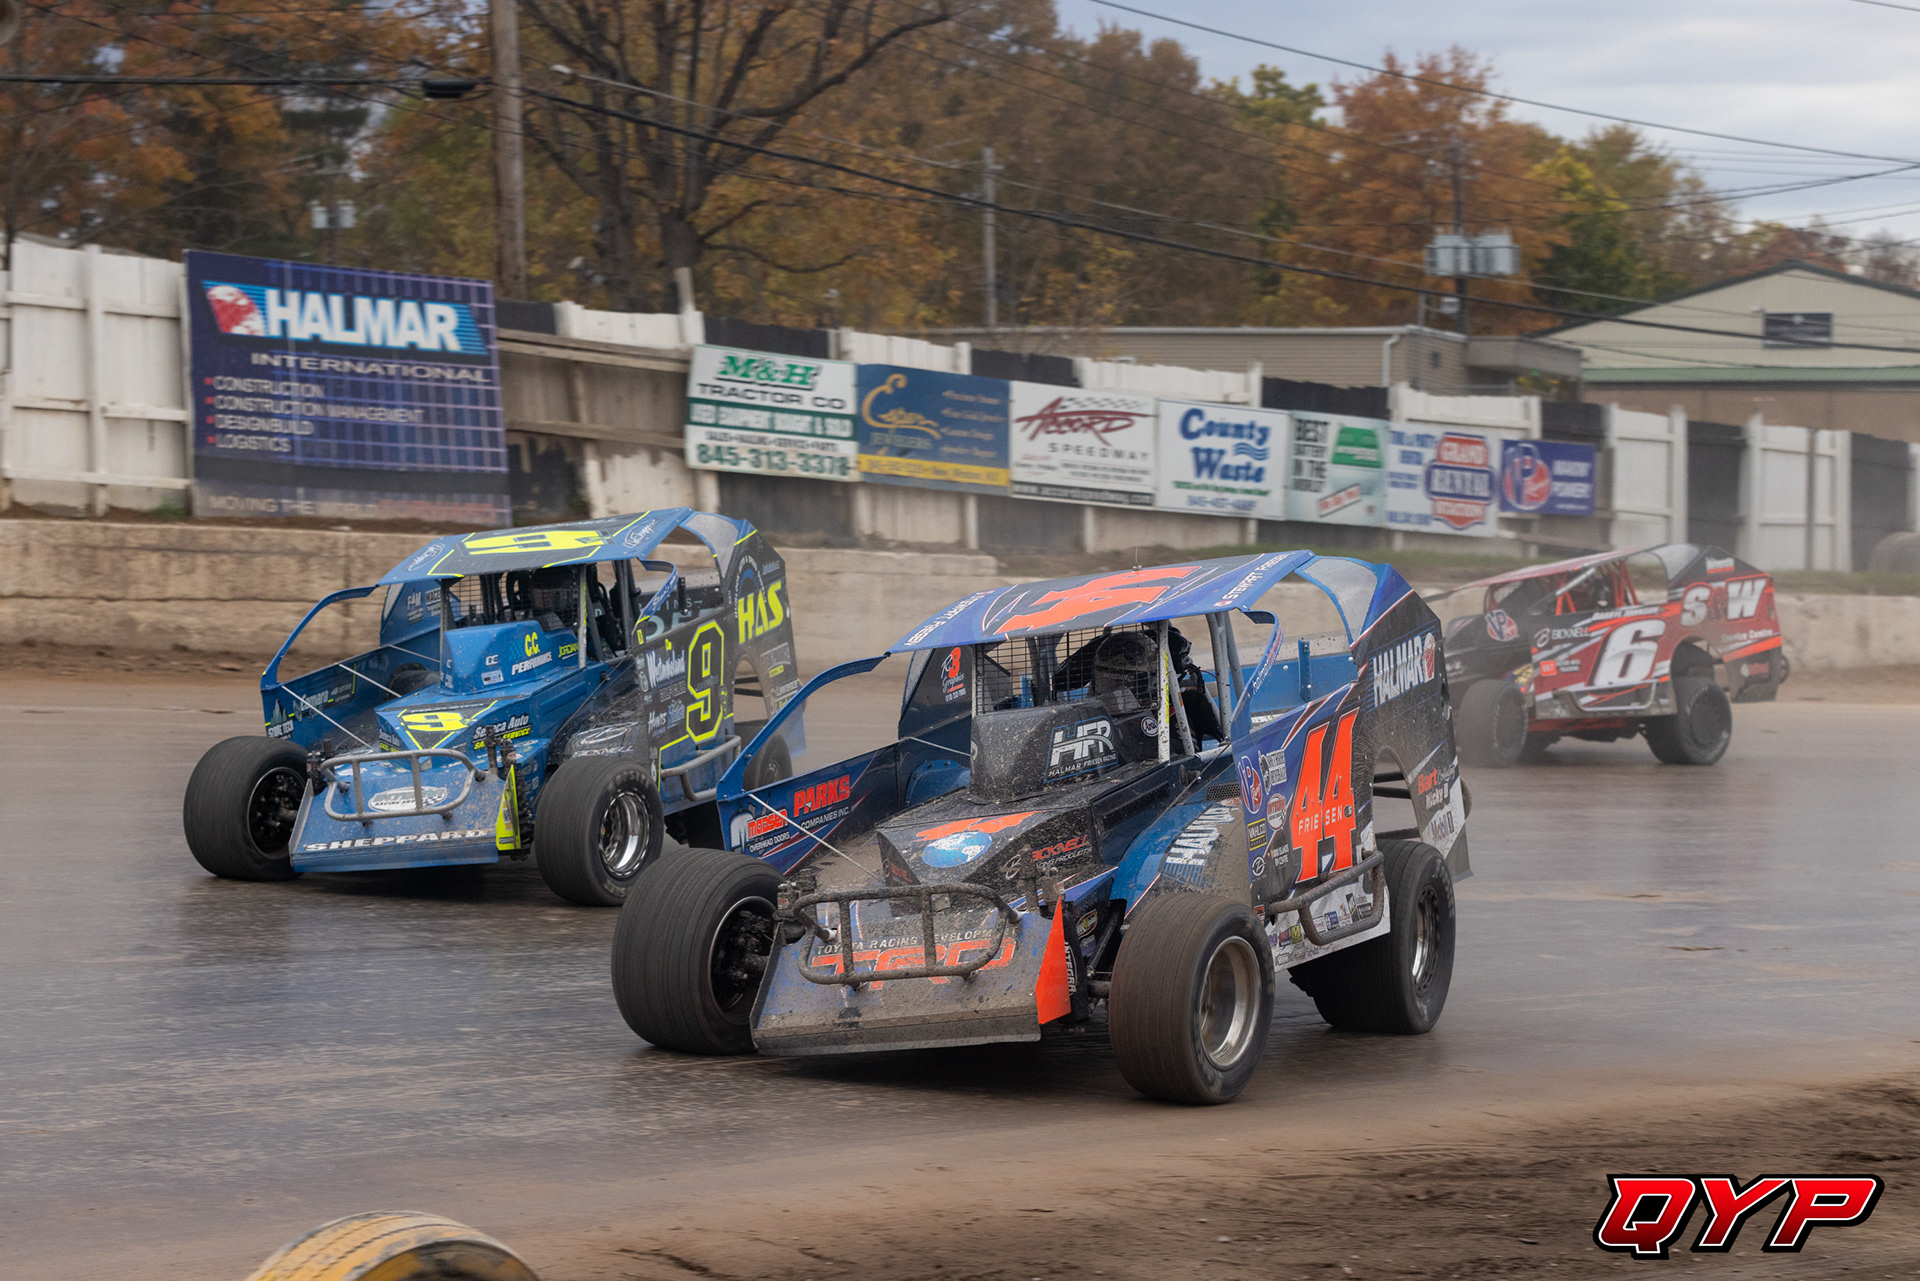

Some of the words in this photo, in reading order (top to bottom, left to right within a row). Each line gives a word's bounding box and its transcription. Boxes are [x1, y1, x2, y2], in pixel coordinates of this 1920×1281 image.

[265, 289, 462, 350] HALMAR
[251, 353, 491, 383] INTERNATIONAL
[718, 355, 820, 388] M&H
[213, 375, 325, 398] CONSTRUCTION
[699, 383, 804, 406] TRACTOR
[813, 396, 847, 411] CO
[1180, 408, 1271, 445] County
[216, 433, 292, 452] LOGISTICS
[1047, 442, 1150, 460] SPEEDWAY
[1191, 447, 1266, 483] Waste
[1222, 571, 1265, 600] STEWART
[1593, 619, 1667, 688] 6
[686, 619, 725, 744] 9
[1373, 634, 1424, 707] HALMAR
[508, 714, 530, 730] Auto
[793, 774, 850, 818] PARKS
[1290, 706, 1360, 884] 44
[800, 810, 837, 830] COMPANIES
[303, 829, 484, 851] SHEPPARD
[817, 942, 865, 955] TOYTA
[869, 937, 918, 949] RACING
